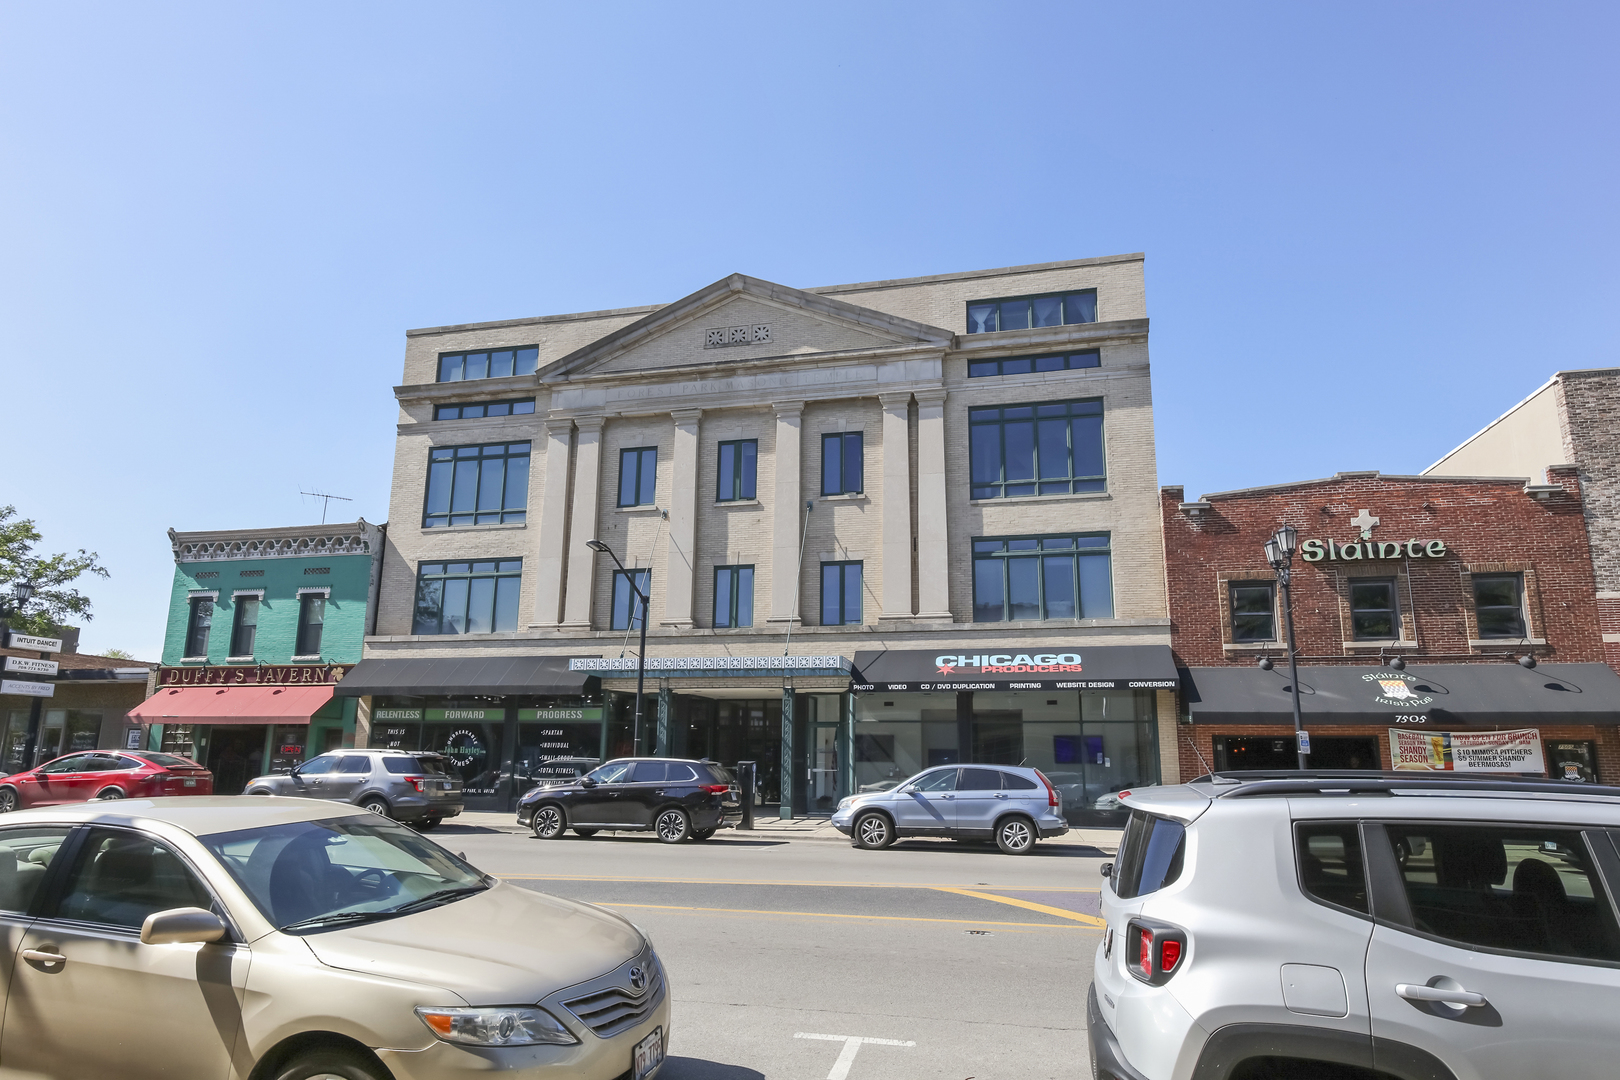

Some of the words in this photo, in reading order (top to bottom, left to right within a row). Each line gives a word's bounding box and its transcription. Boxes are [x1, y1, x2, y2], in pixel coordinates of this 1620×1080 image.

[617, 385, 676, 399] FOREST
[682, 381, 717, 394] PARK
[725, 375, 794, 389] MASONIC
[803, 370, 863, 384] TEMPLE
[935, 653, 1082, 667] CHICAGO
[981, 665, 1082, 673] PRODUCERS
[170, 669, 245, 683] DUFFY'S
[254, 668, 326, 682] TAVERN
[376, 710, 420, 719] RELENTLESS
[444, 710, 485, 719] FORWARD
[536, 710, 583, 719] PROGRESS
[1395, 715, 1427, 724] 7505
[447, 730, 478, 745] UNBREAKABLE
[1399, 746, 1427, 754] SHANDY
[1400, 754, 1428, 763] SEASON
